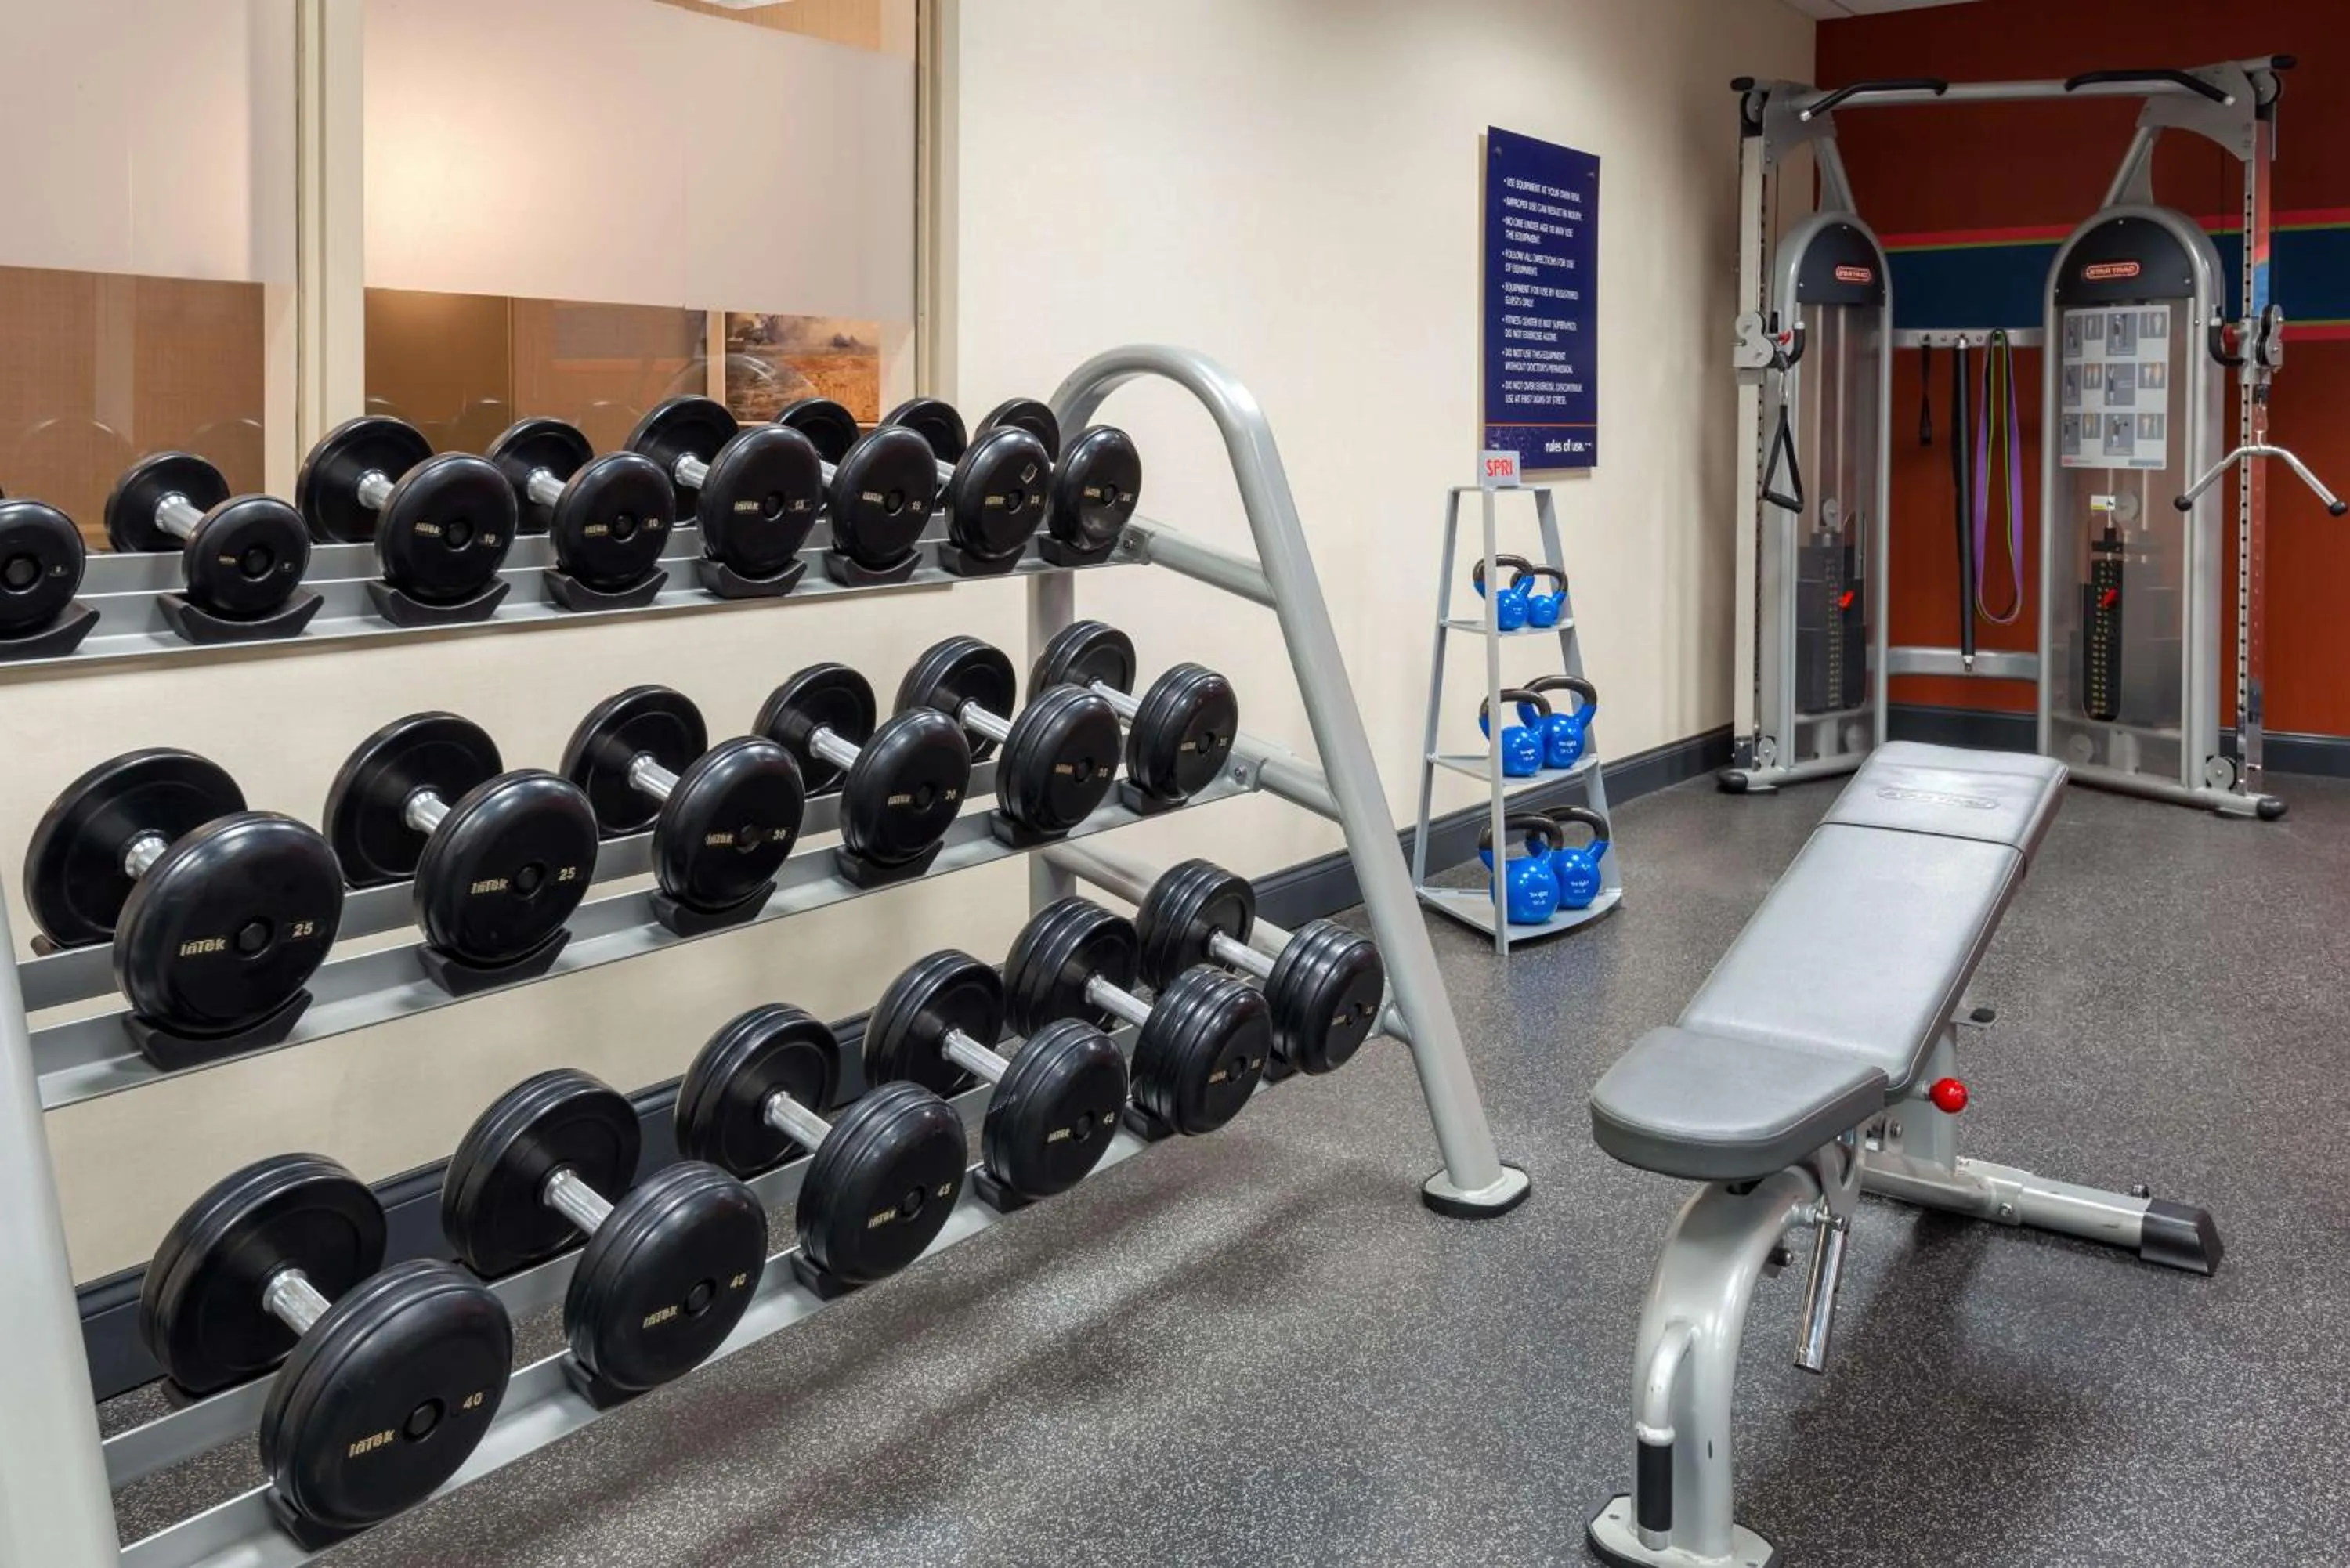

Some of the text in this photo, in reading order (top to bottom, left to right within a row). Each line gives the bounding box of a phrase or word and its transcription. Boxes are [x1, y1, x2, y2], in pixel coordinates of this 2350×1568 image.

[1546, 439, 1562, 453] rules
[1563, 439, 1571, 452] of
[559, 865, 577, 881] 25
[291, 921, 314, 938] 25
[730, 1272, 747, 1289] 40
[463, 1391, 483, 1410] 40
